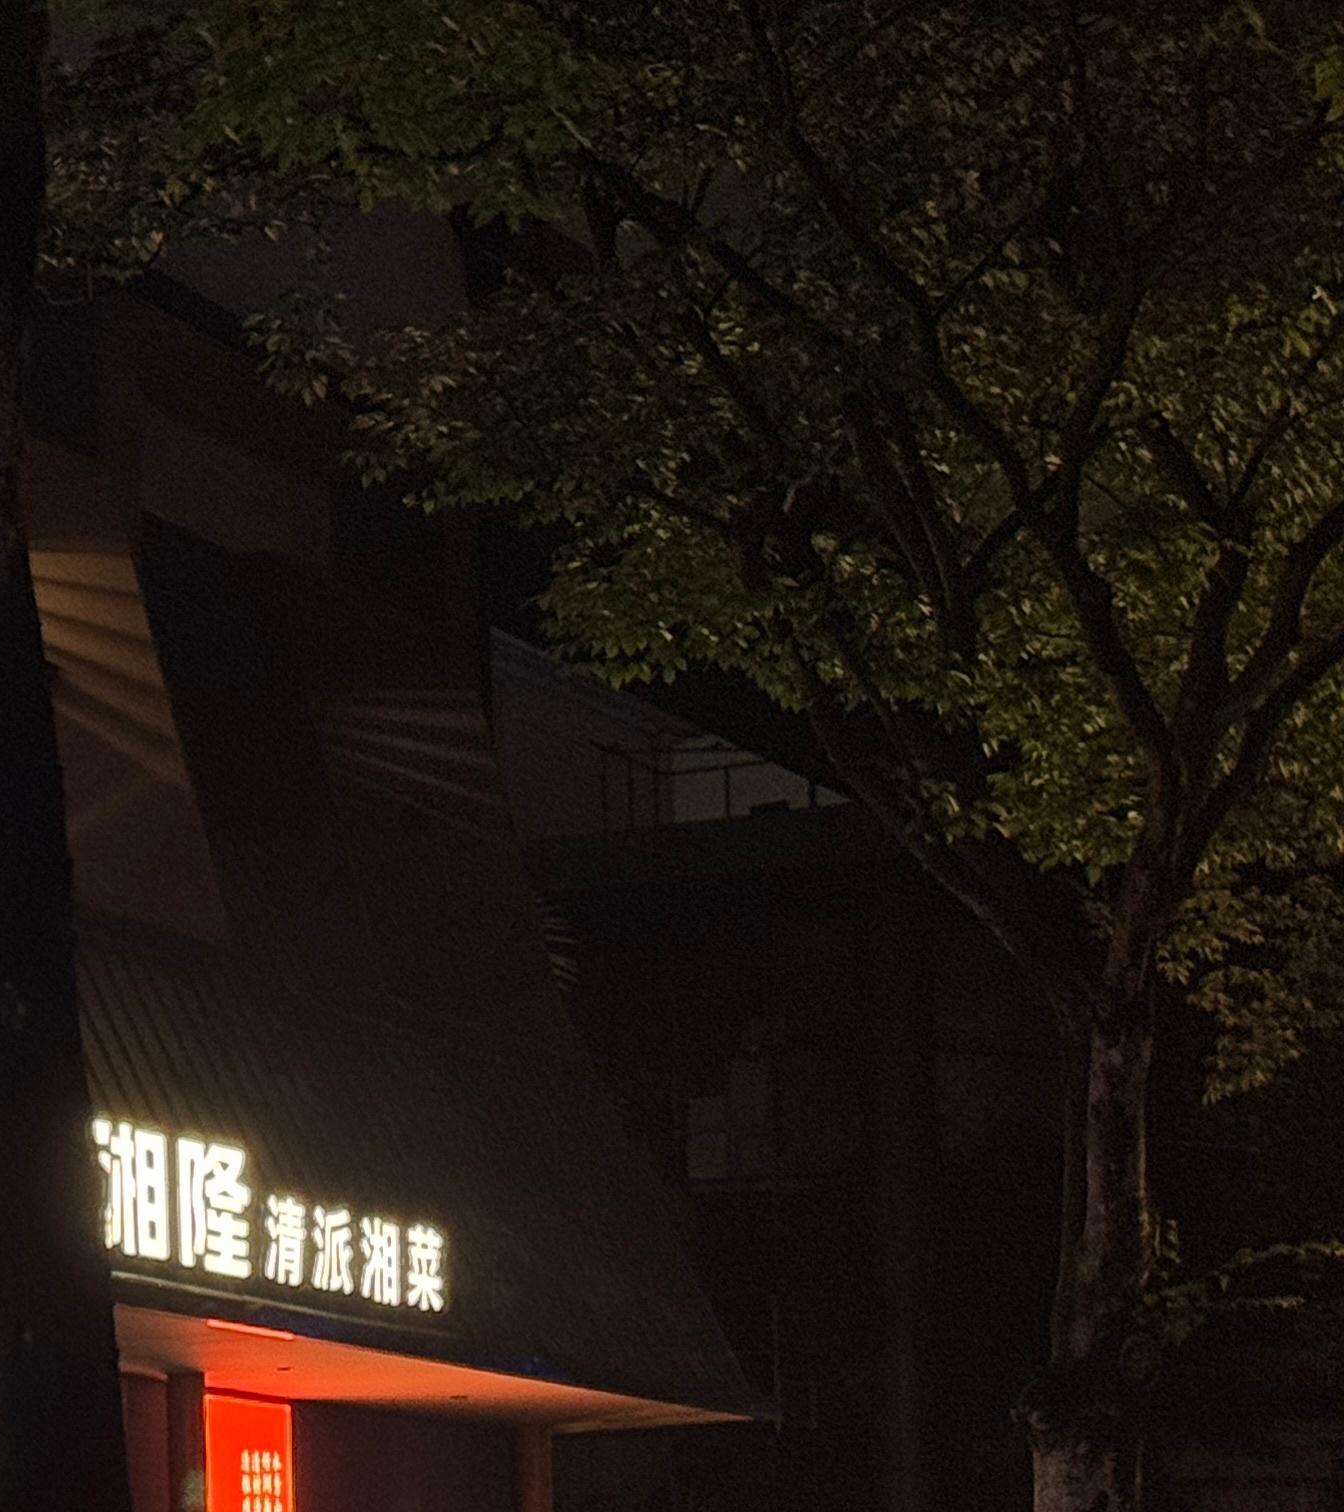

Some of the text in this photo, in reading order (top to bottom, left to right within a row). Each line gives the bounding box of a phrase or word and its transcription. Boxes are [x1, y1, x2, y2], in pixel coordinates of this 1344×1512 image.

[92, 1118, 445, 1313] 湘隆 清派湘菜
